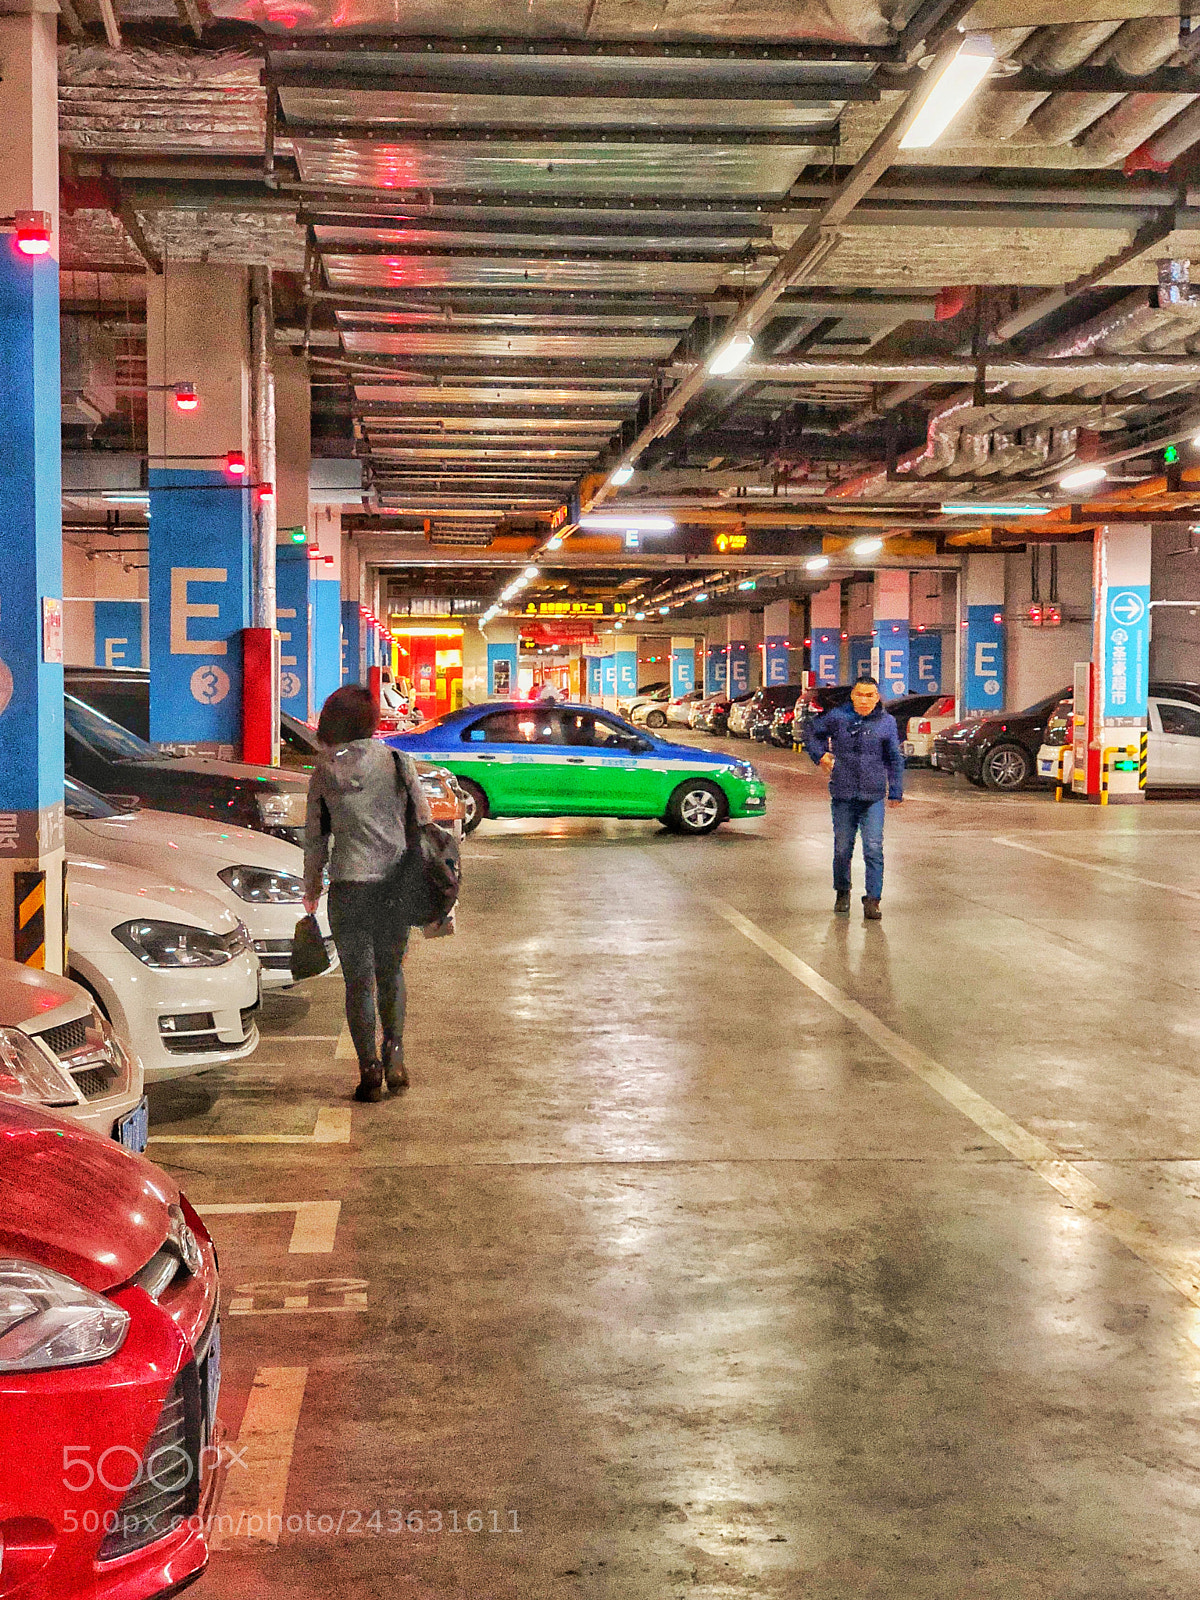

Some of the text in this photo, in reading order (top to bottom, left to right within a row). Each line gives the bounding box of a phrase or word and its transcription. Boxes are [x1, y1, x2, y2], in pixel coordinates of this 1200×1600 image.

[625, 530, 639, 547] E
[170, 567, 228, 655] E
[770, 658, 786, 680] E
[819, 655, 836, 679] E
[884, 650, 904, 679] E
[918, 655, 935, 680] E
[975, 642, 998, 676] E
[606, 667, 616, 682] E
[621, 666, 633, 682] E
[678, 665, 690, 681] E
[714, 663, 727, 681] E
[733, 661, 747, 680] E
[202, 671, 219, 697] 3
